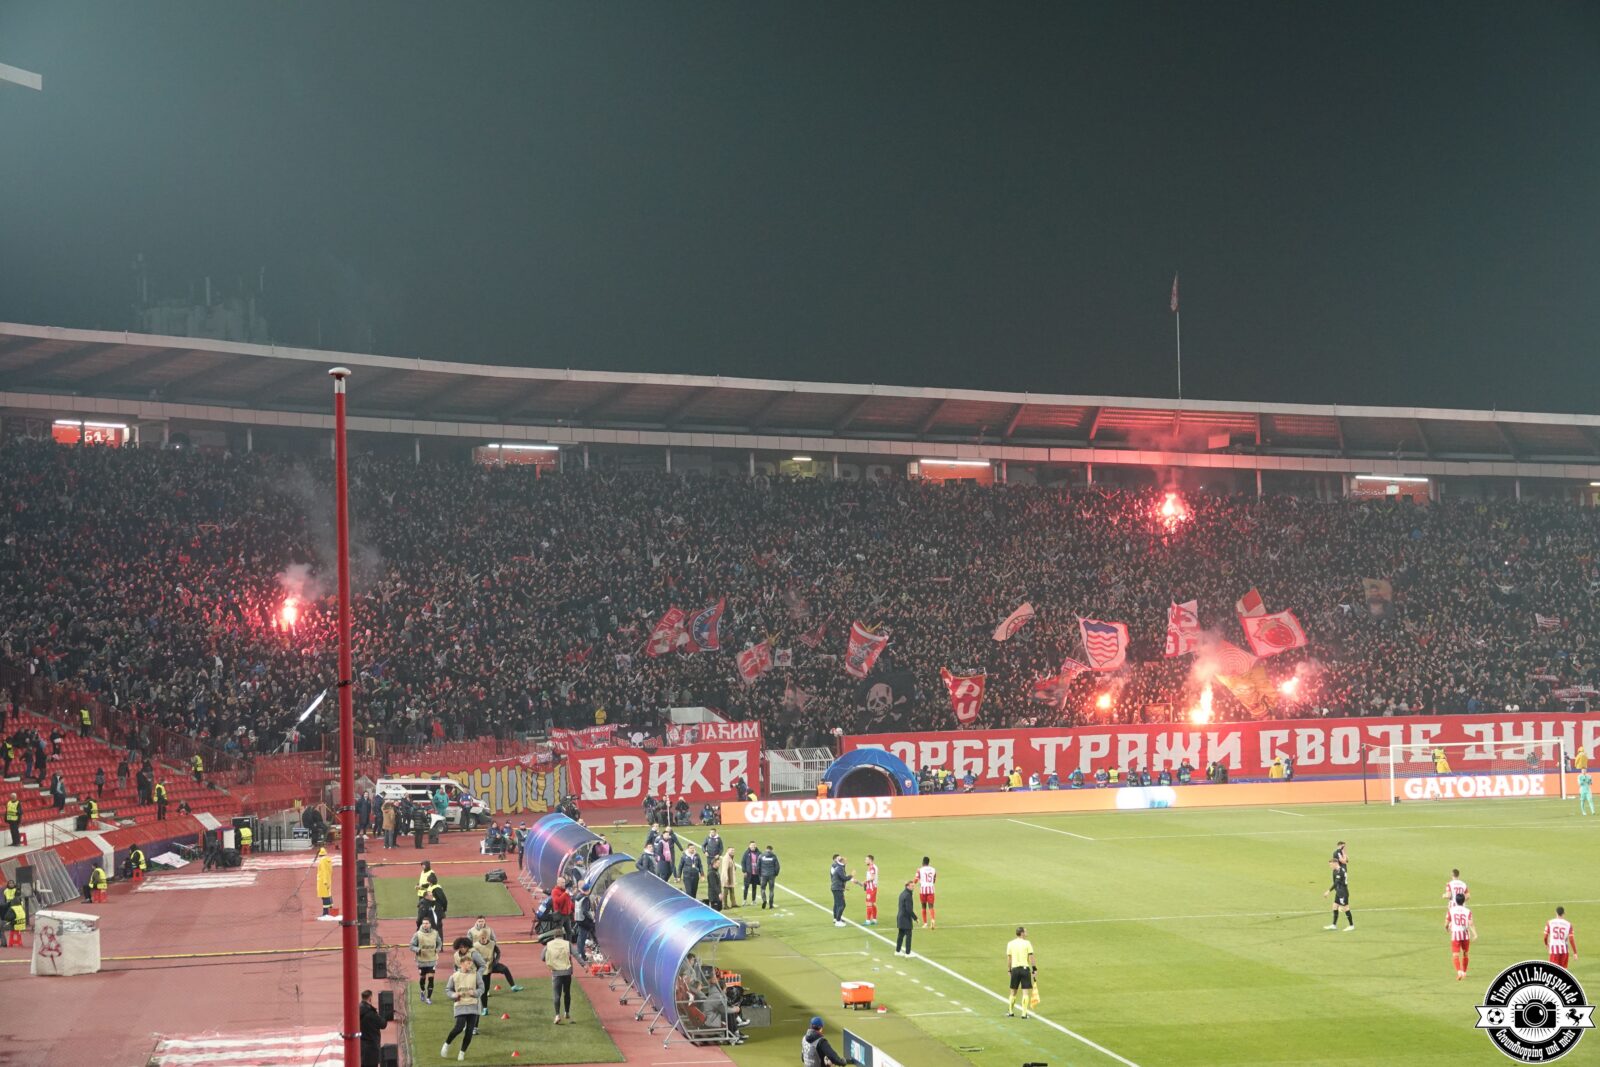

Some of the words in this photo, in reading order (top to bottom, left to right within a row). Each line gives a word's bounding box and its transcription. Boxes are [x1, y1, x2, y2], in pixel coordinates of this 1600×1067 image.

[855, 738, 1015, 778] ОРБА
[1030, 731, 1242, 774] ТРАЖИ
[578, 750, 748, 801] СВАКА
[1404, 774, 1545, 800] GATORADE
[744, 796, 892, 824] GATORADE
[1454, 914, 1466, 926] 66
[1553, 926, 1566, 940] 55
